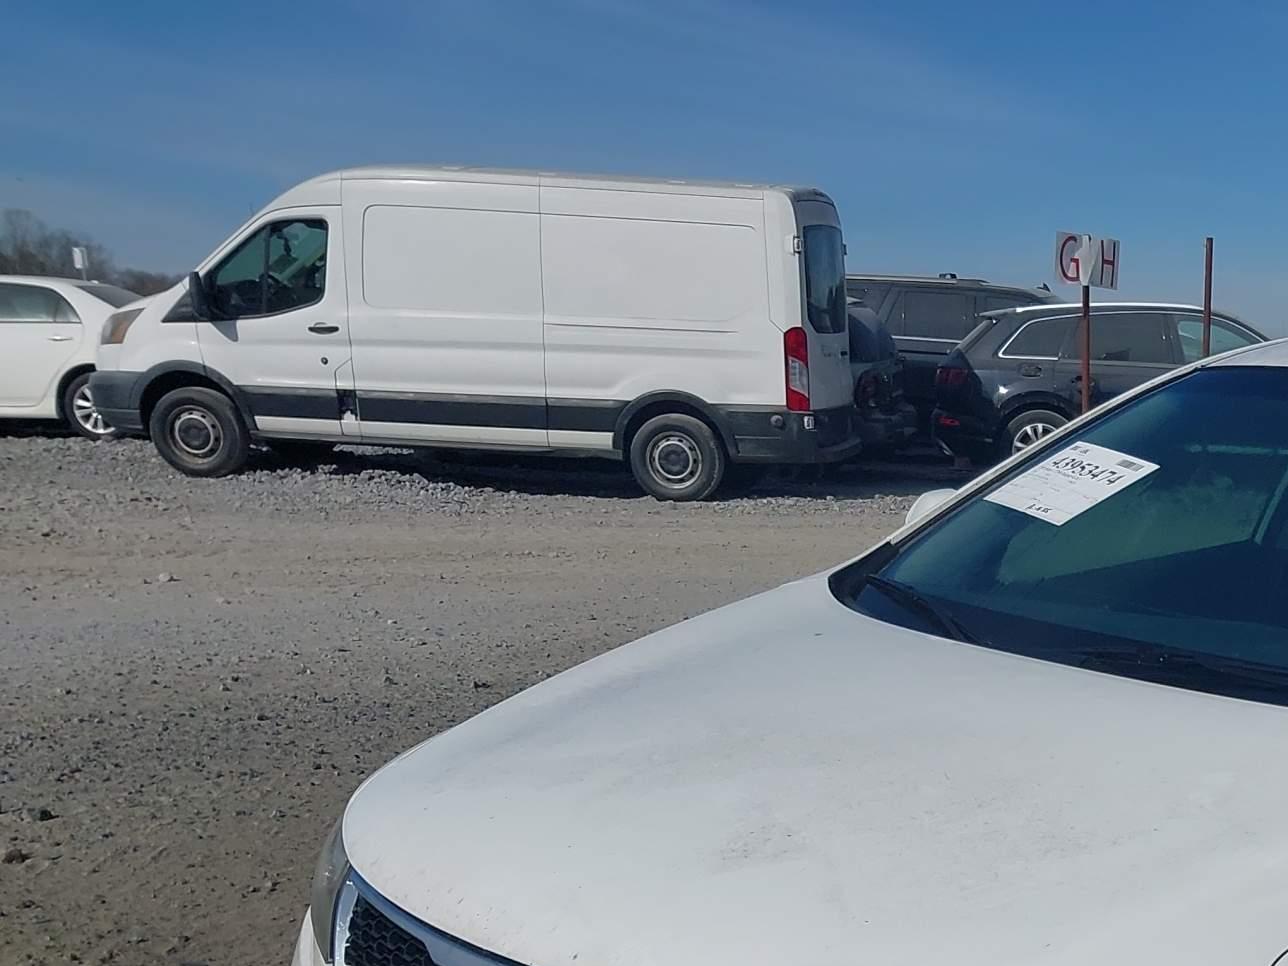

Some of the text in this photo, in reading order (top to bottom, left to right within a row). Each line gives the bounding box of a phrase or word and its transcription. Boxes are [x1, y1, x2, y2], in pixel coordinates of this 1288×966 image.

[1059, 235, 1080, 282] G
[1100, 239, 1116, 287] H
[1052, 456, 1126, 486] 43953474
